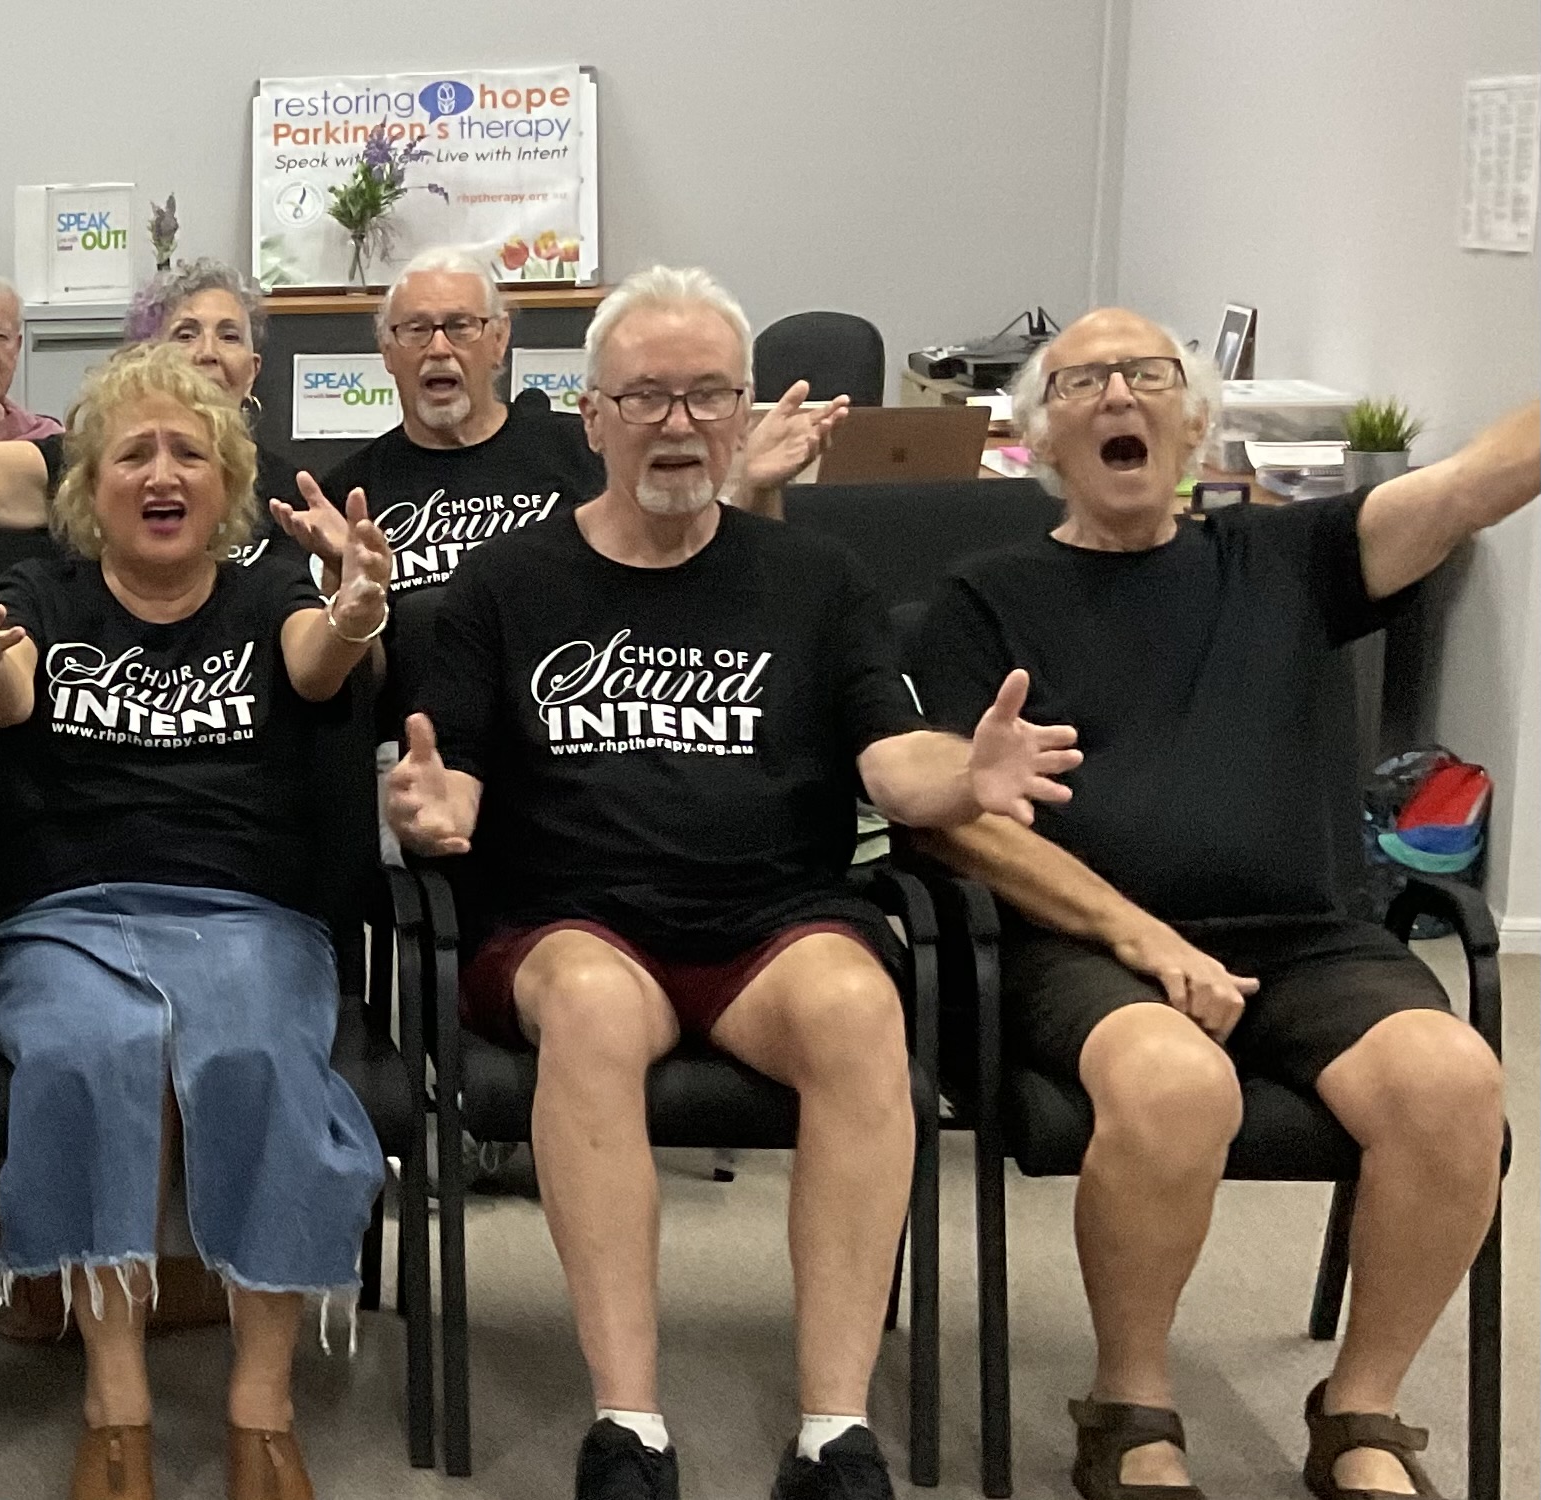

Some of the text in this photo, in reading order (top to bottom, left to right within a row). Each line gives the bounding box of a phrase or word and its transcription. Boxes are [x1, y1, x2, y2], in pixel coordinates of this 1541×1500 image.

[274, 83, 571, 119] restoring hope
[458, 116, 572, 142] therapy
[275, 153, 329, 173] Speak
[437, 148, 469, 163] Live
[474, 147, 511, 162] with
[517, 147, 568, 161] Intent
[57, 211, 111, 232] SPEAK
[81, 230, 127, 251] OUT!
[303, 372, 364, 390] SPEAK
[523, 373, 584, 391] SPEAK
[343, 388, 394, 406] OUT!
[436, 494, 541, 517] CHOIR OF
[125, 650, 235, 689] CHOIR OF
[619, 645, 749, 670] CHOIR OF
[46, 641, 254, 713] Sound
[530, 628, 772, 725] Sound
[53, 686, 256, 736] INTENT
[547, 701, 765, 742] INTENT
[51, 722, 253, 749] www.rhptherapy.org.au
[550, 737, 754, 756] www.rhptherapy.org.au
